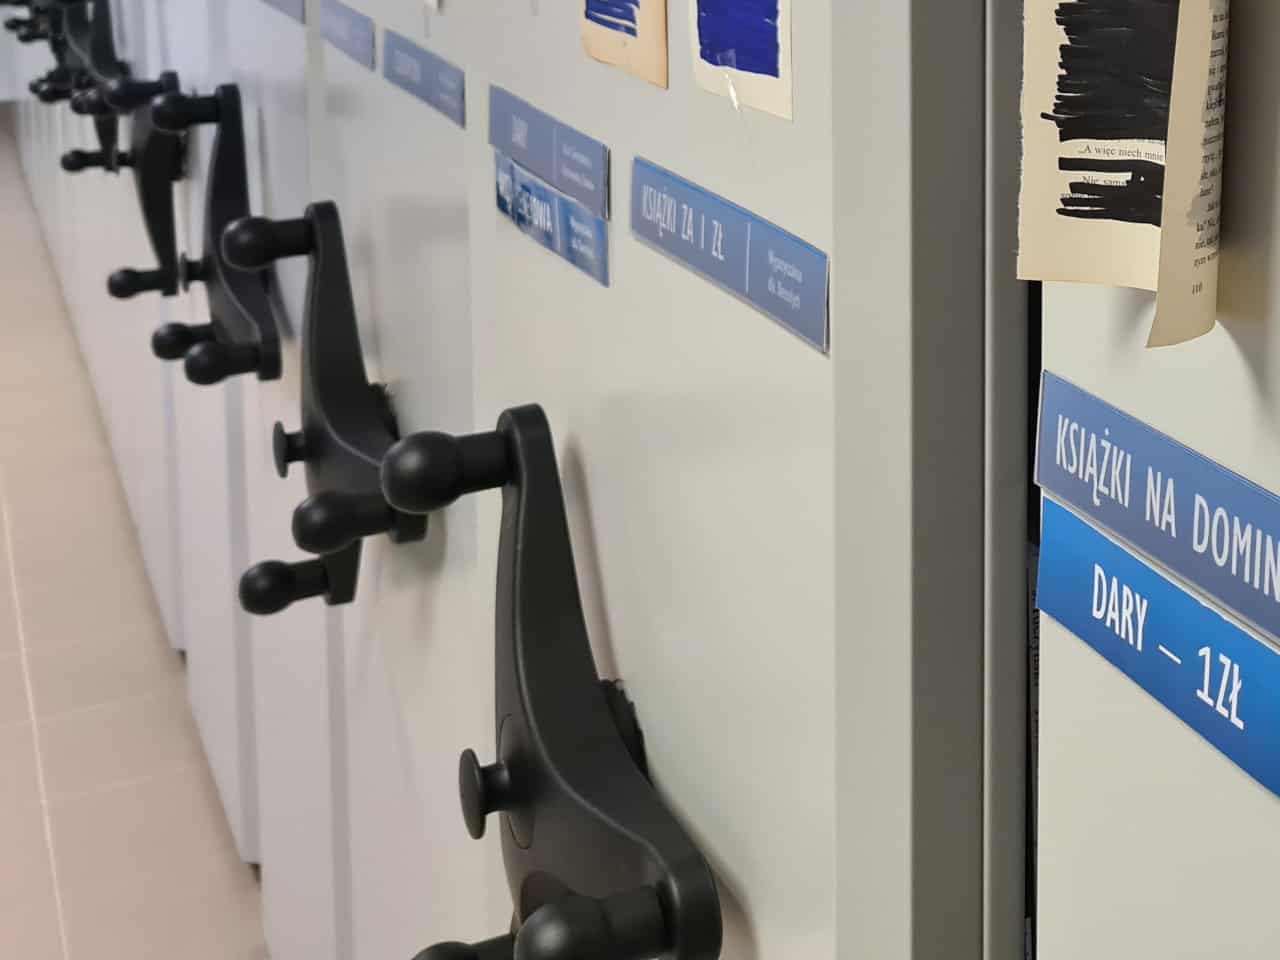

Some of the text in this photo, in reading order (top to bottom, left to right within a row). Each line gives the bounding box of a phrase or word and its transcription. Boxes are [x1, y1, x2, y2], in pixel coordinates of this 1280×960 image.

[1095, 146, 1117, 158] więc
[1056, 413, 1132, 507] KSIĄŻKI
[1145, 465, 1177, 538] NA
[1091, 563, 1148, 652] DARY
